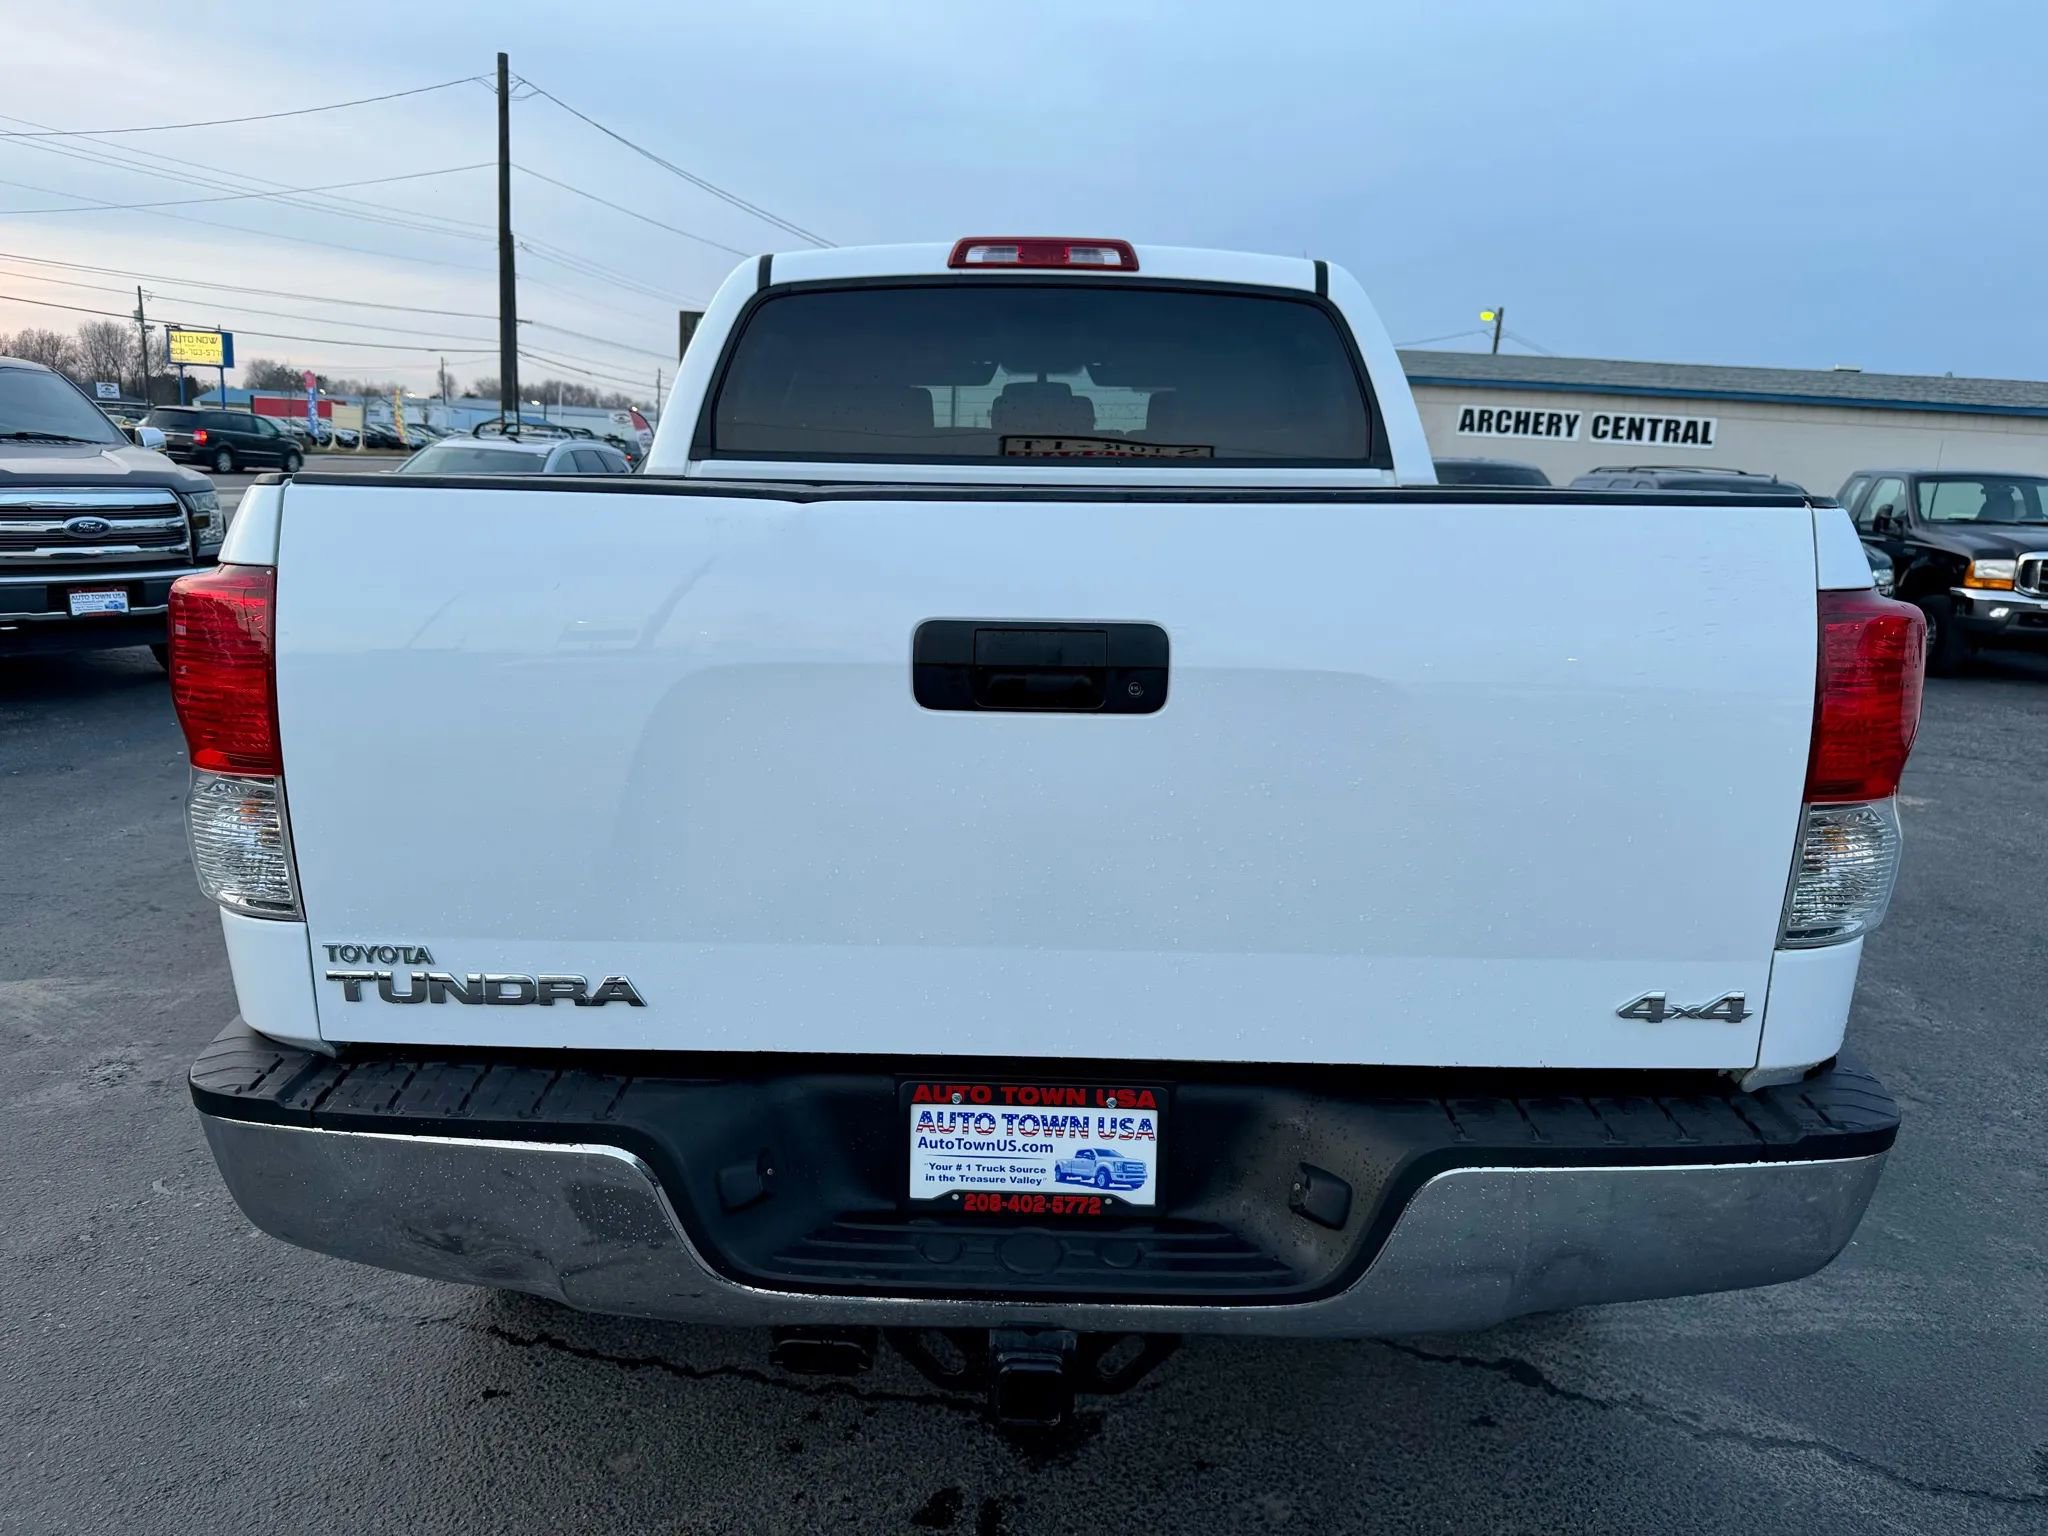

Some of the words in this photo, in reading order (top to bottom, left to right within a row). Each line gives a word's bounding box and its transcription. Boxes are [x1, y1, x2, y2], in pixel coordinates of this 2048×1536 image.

[170, 335, 194, 344] AUTO
[196, 336, 218, 345] NOW
[1458, 408, 1580, 438] ARCHERY
[1591, 415, 1713, 445] CENTRAL
[79, 522, 103, 533] Ford
[71, 593, 90, 601] AUTO
[321, 942, 436, 965] TOYOTA
[325, 969, 648, 1007] TUNDRA
[1616, 990, 1753, 1024] 4x4
[912, 1084, 992, 1104] AUTO
[1000, 1086, 1086, 1106] TOWN
[1095, 1089, 1157, 1108] USA
[915, 1110, 997, 1135] AUTO
[1001, 1112, 1090, 1140] TOWN
[1097, 1116, 1156, 1141] USA
[917, 1136, 1054, 1154] AutoTownUS.com
[925, 1173, 936, 1182] in
[938, 1174, 956, 1183] the
[959, 1174, 1007, 1184] Treasure
[955, 1163, 963, 1171] #
[966, 1163, 972, 1172] 1
[974, 1163, 1006, 1173] Truck
[1009, 1164, 1047, 1174] Source
